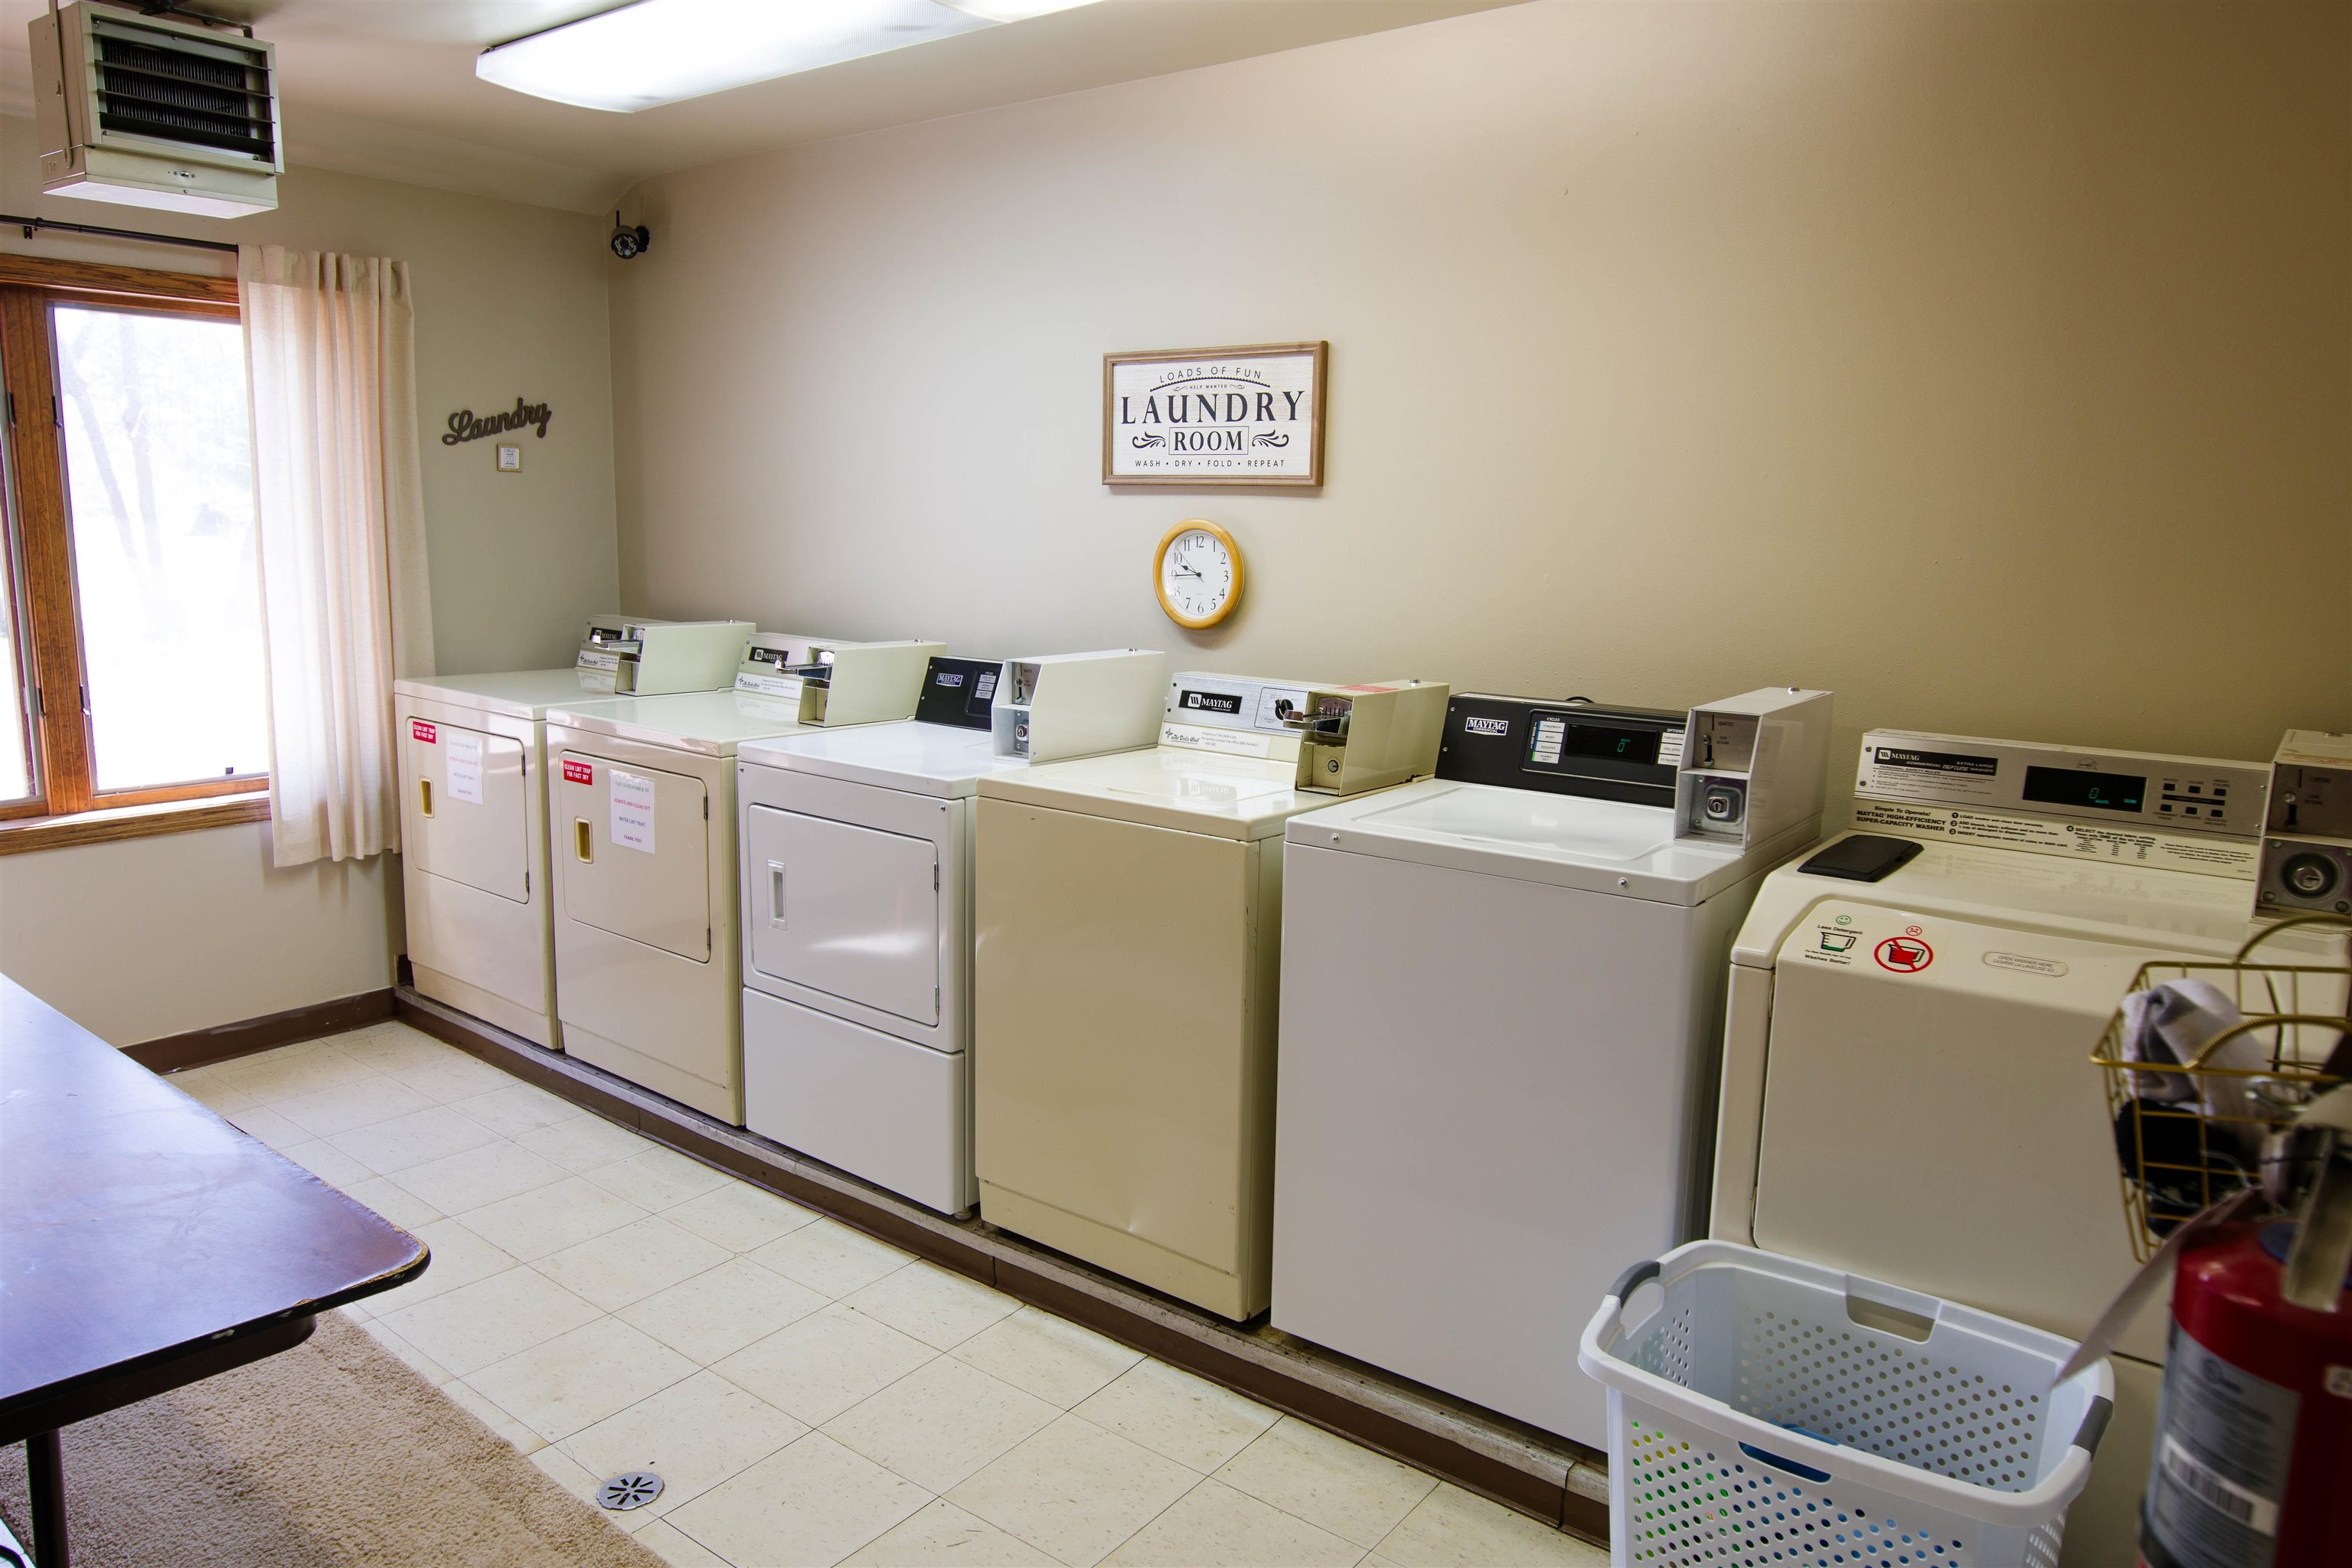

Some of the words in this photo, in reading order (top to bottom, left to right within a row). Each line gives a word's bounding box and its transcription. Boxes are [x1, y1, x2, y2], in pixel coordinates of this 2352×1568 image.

[1159, 367, 1202, 383] LOADS
[1210, 366, 1227, 375] OF
[1236, 367, 1261, 379] FUN
[1121, 390, 1305, 424] LAUNDRY
[442, 397, 552, 446] Laundry
[1174, 430, 1243, 451] ROOM
[1184, 539, 1191, 551] 11
[1196, 535, 1204, 548] 12
[1174, 552, 1182, 565] 10
[1220, 552, 1227, 564] 2
[1171, 570, 1178, 582] 9
[1223, 570, 1229, 583] 3
[1174, 586, 1181, 597] 8
[1219, 588, 1225, 599] 4
[1186, 597, 1191, 609] 7
[1197, 602, 1204, 614] 6
[1210, 598, 1217, 610] 5
[763, 652, 782, 662] MAYTAG
[938, 674, 961, 684] MAYTAG
[1200, 697, 1233, 709] MAYTAG
[1468, 719, 1505, 730] MAYTAG
[1617, 742, 1625, 753] 0
[1890, 753, 1920, 761] MAYTAG
[2089, 787, 2100, 799] 0
[1857, 816, 1914, 828] SUPER-CAPACITY
[1916, 823, 1945, 831] WASHER
[1886, 814, 1946, 825] HIGH-EFFICIENCY
[1833, 926, 1864, 935] Detergent
